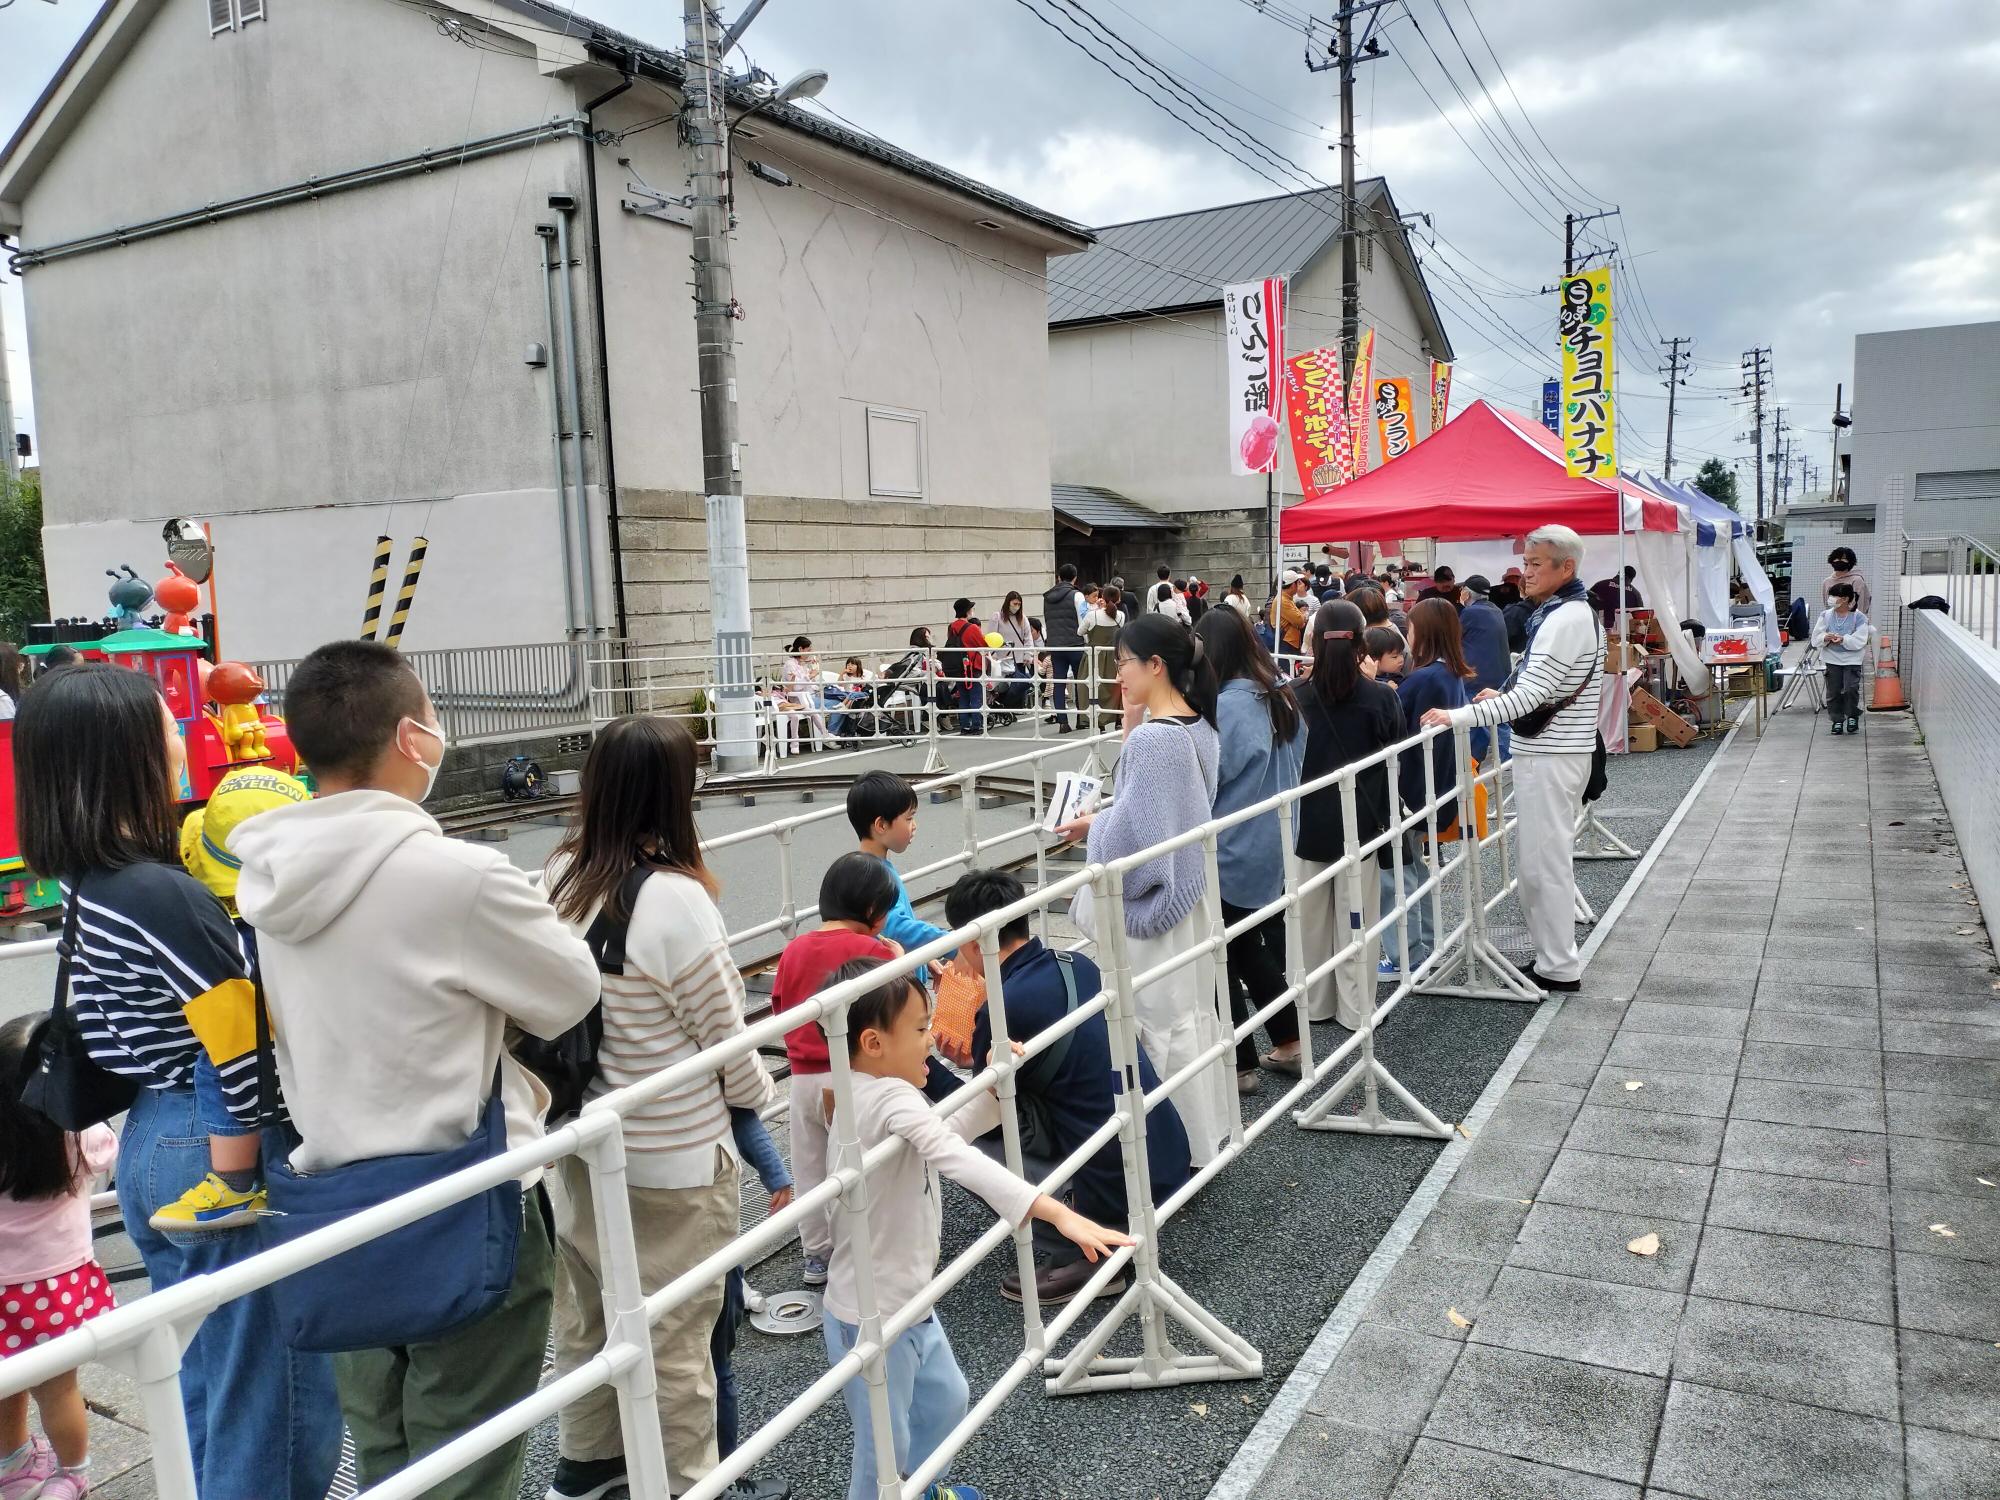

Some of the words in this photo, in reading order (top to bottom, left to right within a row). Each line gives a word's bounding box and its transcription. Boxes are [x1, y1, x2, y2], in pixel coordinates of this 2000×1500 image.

[1569, 325, 1606, 474] チョコバナナ
